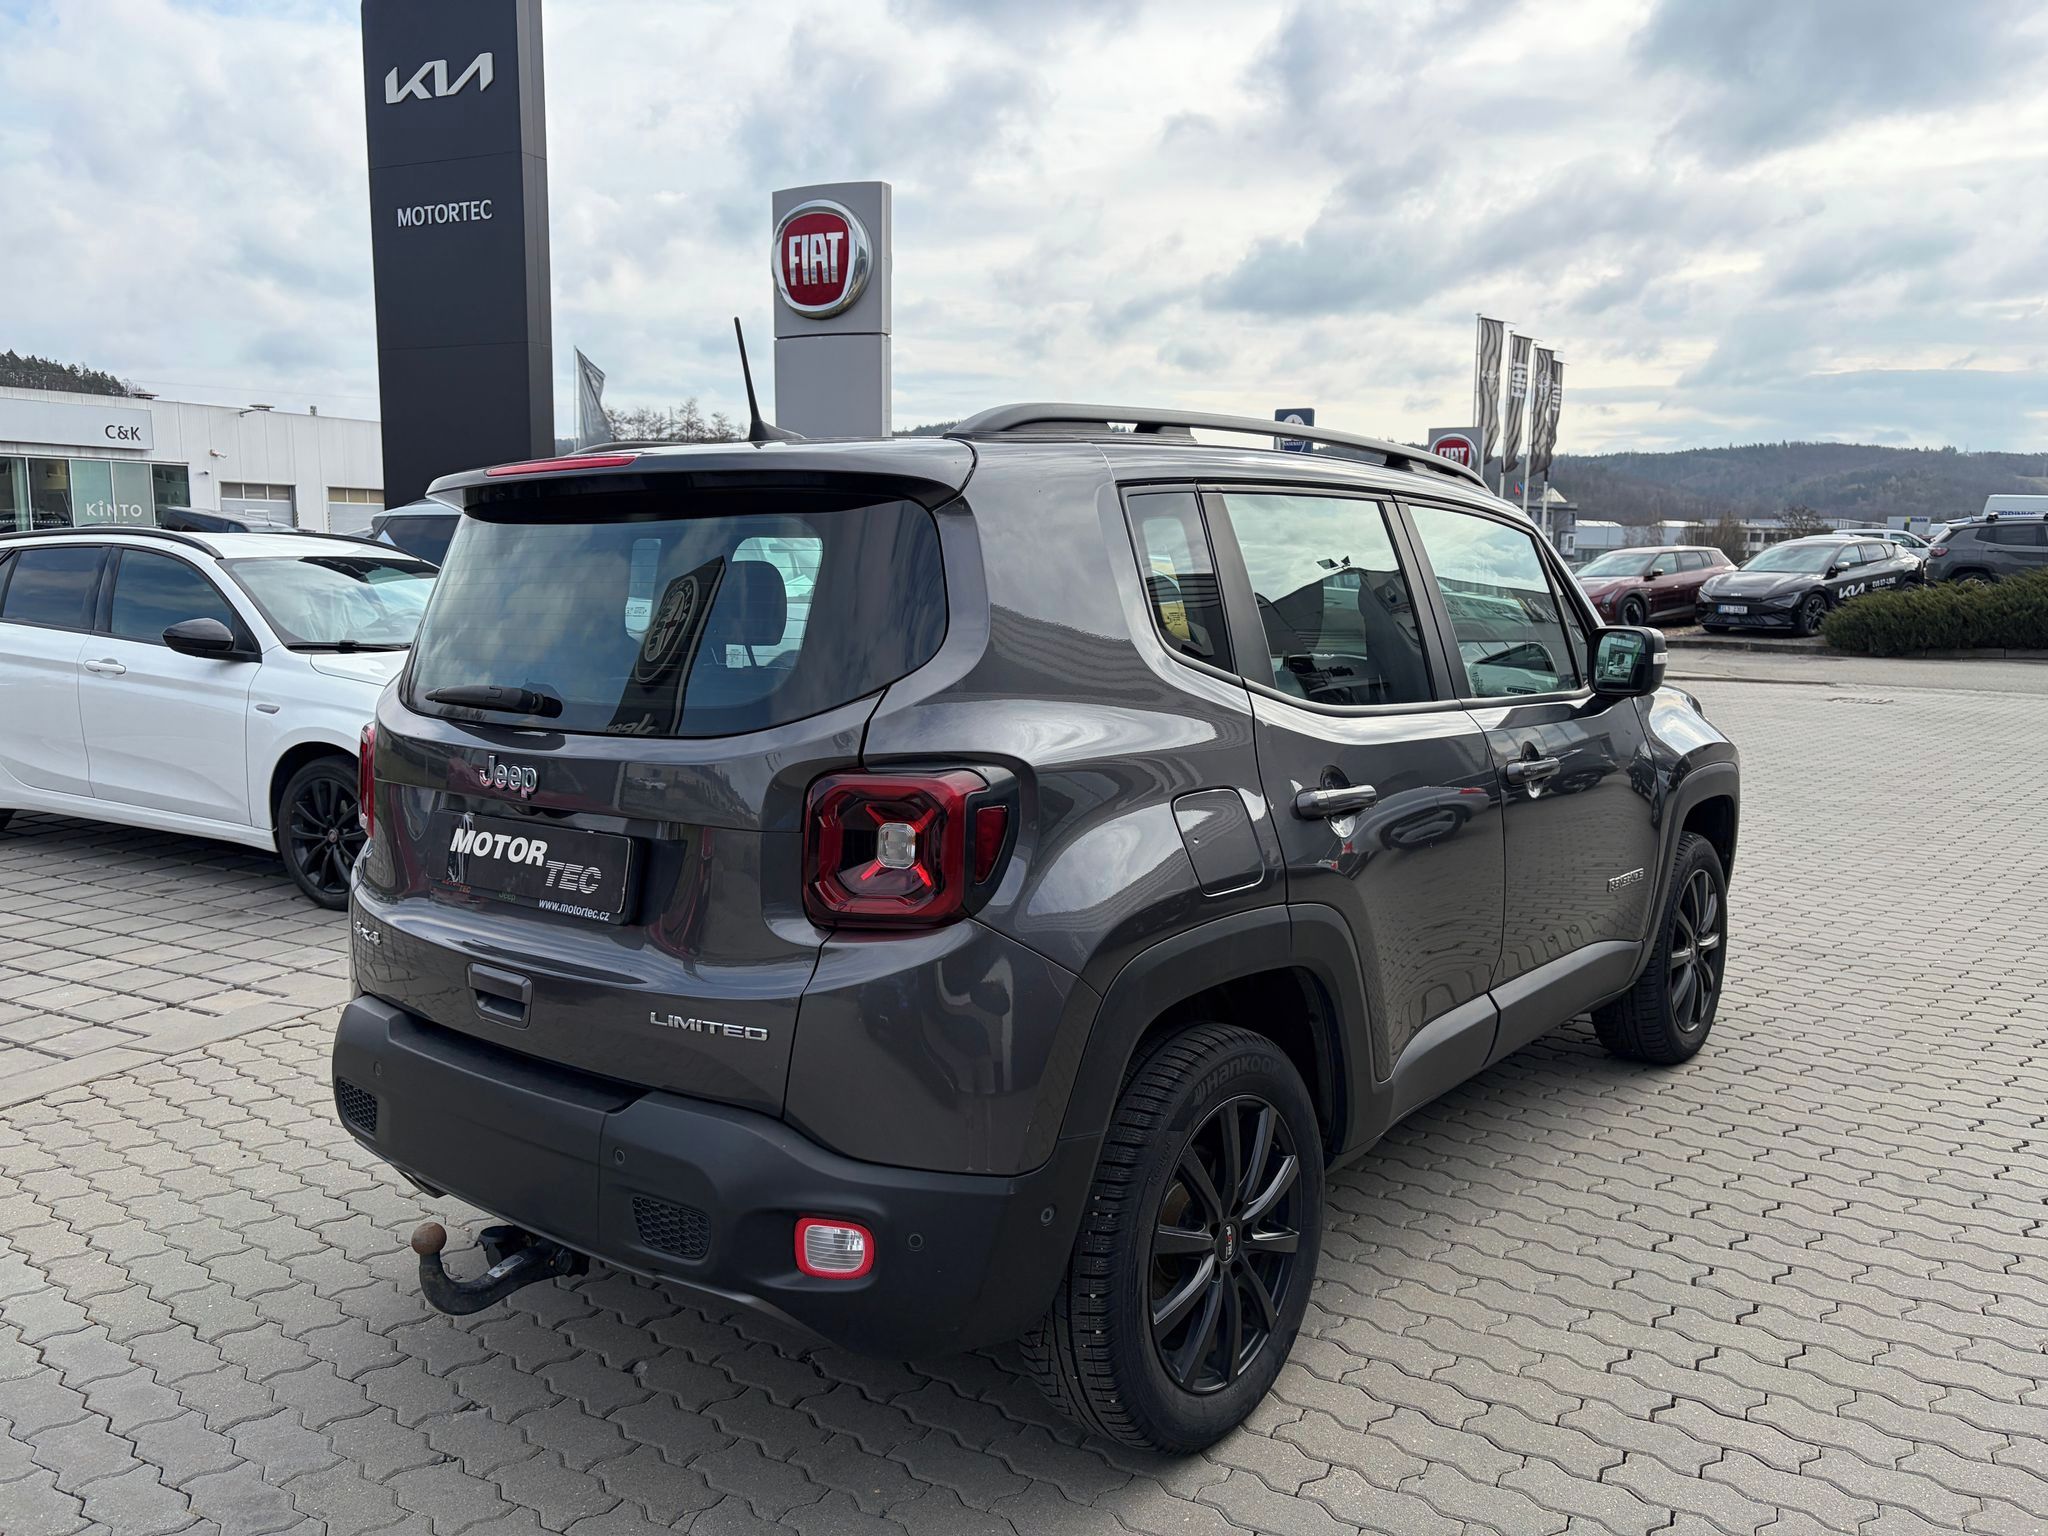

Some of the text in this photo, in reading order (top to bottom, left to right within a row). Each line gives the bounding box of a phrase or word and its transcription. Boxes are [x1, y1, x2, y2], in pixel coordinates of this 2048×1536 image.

[385, 52, 494, 104] KIA
[397, 199, 493, 228] MOTORTEC
[788, 231, 844, 287] FIAT
[105, 424, 141, 441] C&K
[1838, 582, 1866, 600] KIA
[479, 755, 538, 798] Jeep
[450, 828, 548, 867] MOTOR
[545, 860, 602, 894] TEC
[538, 899, 610, 922] www.motortec.cz
[650, 1011, 768, 1041] LIMITED
